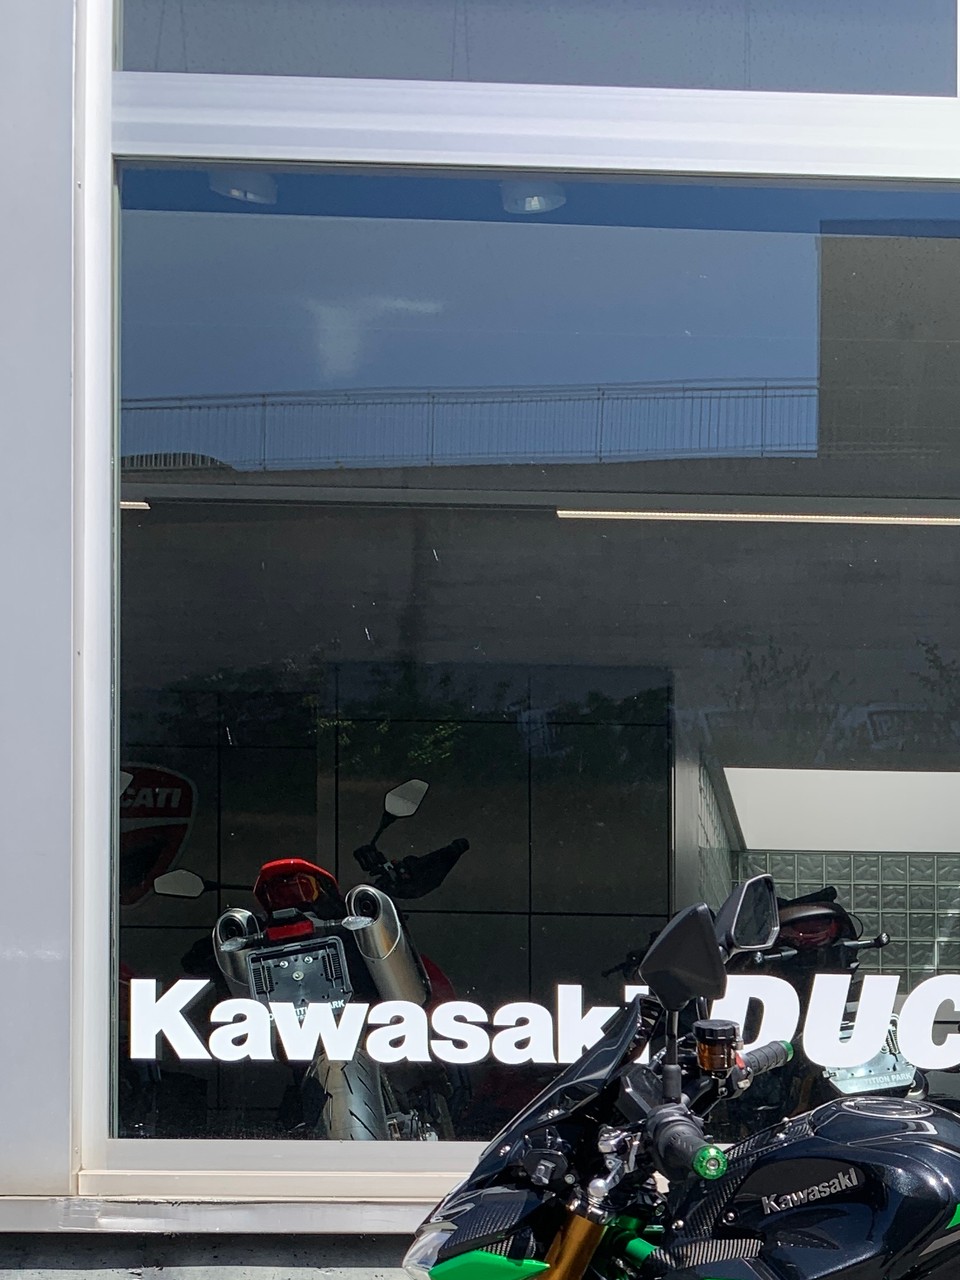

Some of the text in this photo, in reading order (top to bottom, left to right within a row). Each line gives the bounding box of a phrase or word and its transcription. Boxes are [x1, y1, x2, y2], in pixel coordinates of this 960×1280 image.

[120, 787, 182, 809] CATI
[130, 979, 650, 1065] Kawasak
[761, 1167, 859, 1215] Kawasaki
